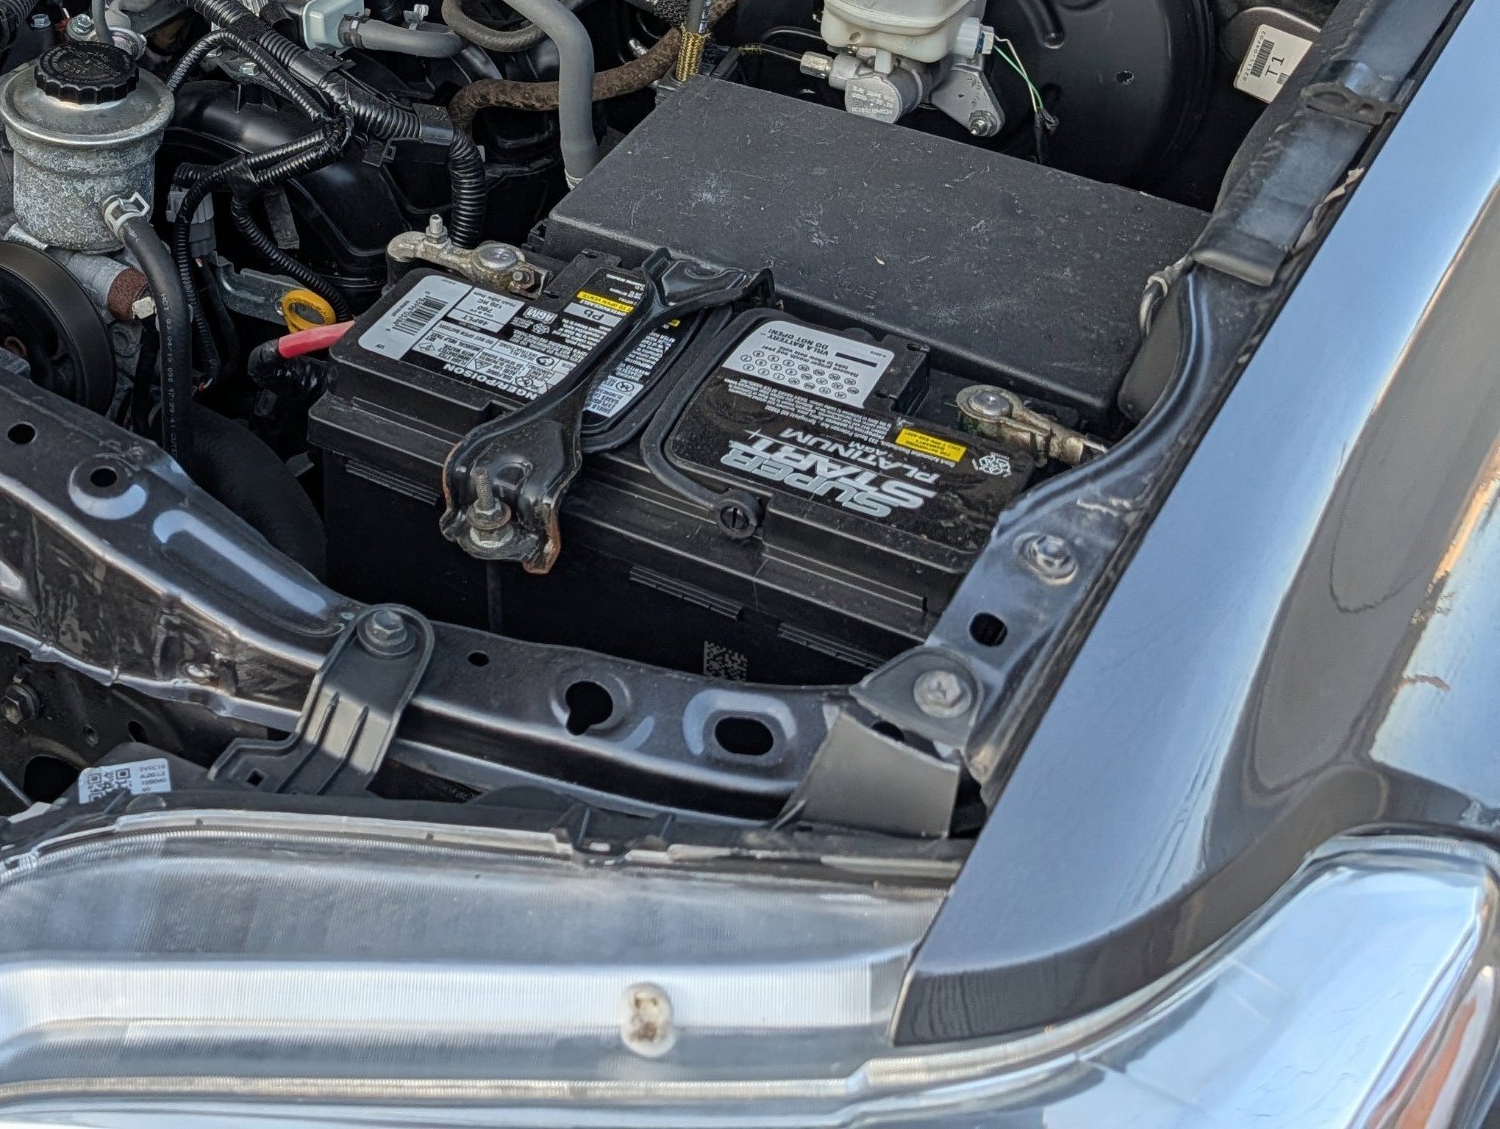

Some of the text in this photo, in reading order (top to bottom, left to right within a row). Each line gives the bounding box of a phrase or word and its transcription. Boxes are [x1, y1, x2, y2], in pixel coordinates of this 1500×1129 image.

[523, 306, 557, 323] AGM
[583, 309, 605, 321] Pb
[765, 333, 830, 356] VRLA BATTERY
[795, 336, 814, 345] NOT
[813, 341, 829, 350] DO
[439, 362, 543, 401] NGER/POISON
[779, 428, 940, 484] PLATINUM
[850, 441, 882, 457] AGM
[728, 436, 938, 509] START
[720, 448, 892, 518] SUPER
